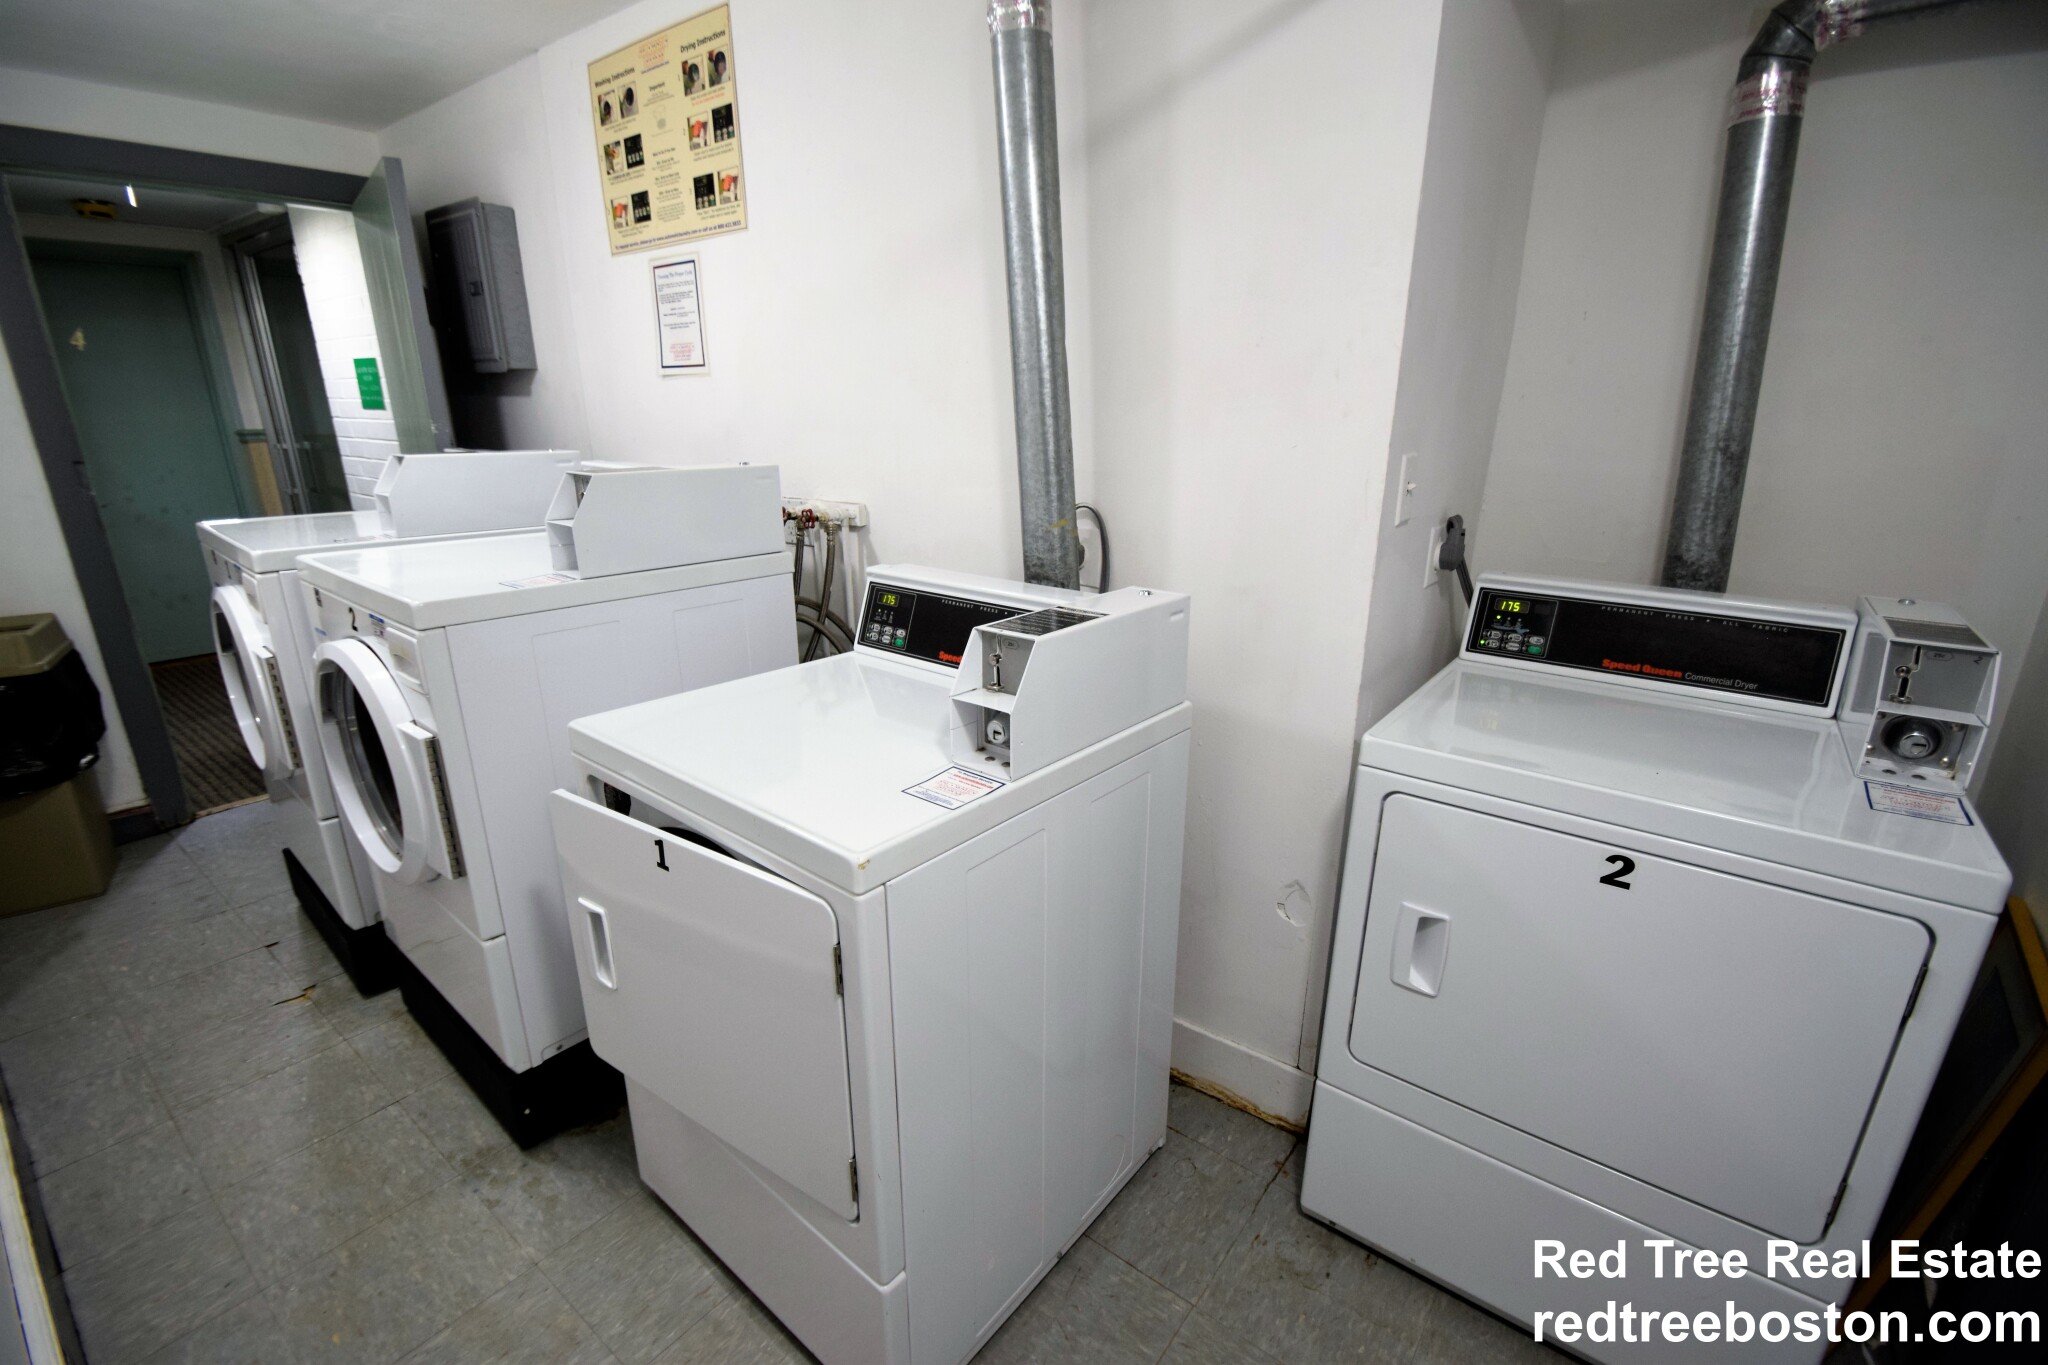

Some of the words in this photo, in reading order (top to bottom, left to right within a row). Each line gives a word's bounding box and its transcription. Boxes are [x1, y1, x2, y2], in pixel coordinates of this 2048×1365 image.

[680, 42, 696, 53] Drying
[697, 30, 726, 46] Instructions
[612, 67, 635, 81] Instructions
[70, 328, 86, 351] 4
[883, 594, 896, 604] 175
[942, 599, 974, 609] PERMANENT
[980, 606, 999, 614] PRESS
[1502, 601, 1520, 612] 175
[349, 606, 358, 632] 2
[1602, 606, 1654, 616] PERMANENT
[1752, 624, 1789, 632] FABRIC
[1602, 658, 1640, 672] Speed
[1642, 664, 1682, 678] Queen
[1685, 672, 1732, 686] Commercial
[1734, 679, 1758, 690] Dryer
[654, 839, 669, 872] 1
[1599, 854, 1635, 890] 2
